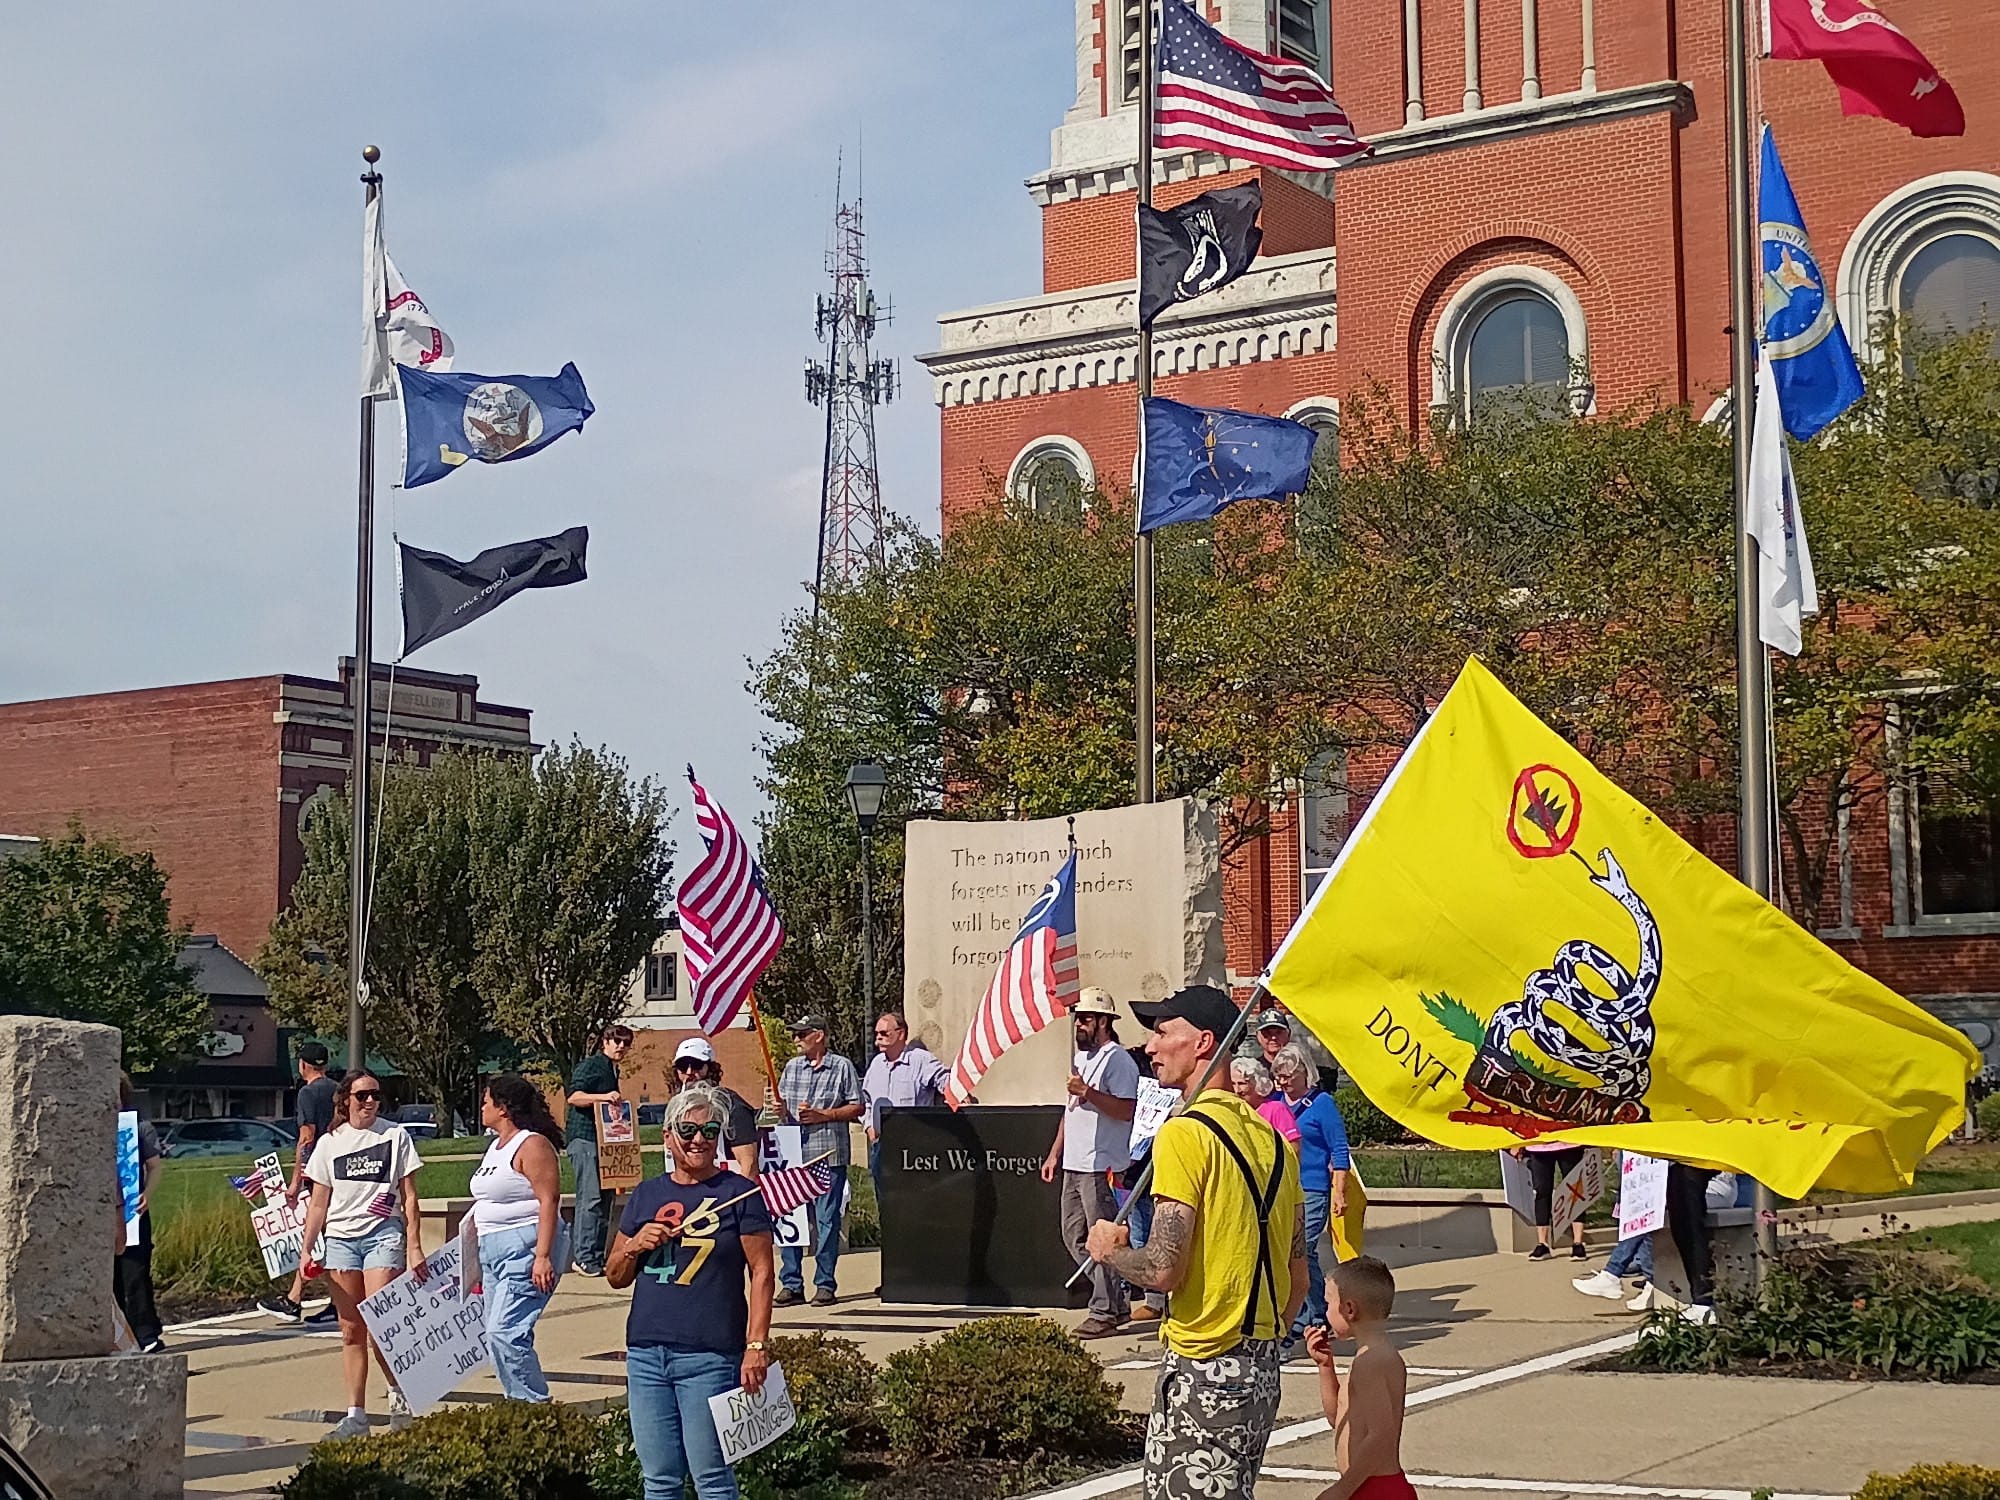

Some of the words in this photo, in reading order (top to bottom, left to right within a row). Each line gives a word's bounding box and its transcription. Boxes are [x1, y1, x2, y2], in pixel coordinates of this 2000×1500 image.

[1776, 229, 1814, 255] UNIT
[951, 848, 987, 868] The
[993, 849, 1050, 866] nation
[951, 880, 1009, 903] forgets
[1016, 881, 1036, 897] its
[1052, 872, 1134, 894] enders
[951, 912, 982, 932] will
[990, 911, 1011, 931] be
[952, 945, 1010, 968] forgot
[1365, 1005, 1457, 1092] DONT
[1478, 1053, 1643, 1126] TRUMP
[257, 1155, 277, 1169] NO
[600, 1144, 614, 1157] NO
[612, 1155, 632, 1166] NO
[902, 1149, 940, 1171] Lest
[946, 1149, 977, 1171] We
[985, 1150, 1045, 1176] Forget
[346, 1167, 380, 1177] BODIES
[364, 1160, 383, 1168] OUR
[1553, 1195, 1565, 1228] NO
[1584, 1153, 1600, 1202] KINGS
[654, 1197, 720, 1237] 86
[379, 1323, 401, 1352] you
[403, 1306, 427, 1336] give
[430, 1296, 440, 1309] a
[393, 1338, 426, 1375] about
[425, 1320, 455, 1352] other
[727, 1384, 768, 1422] NO
